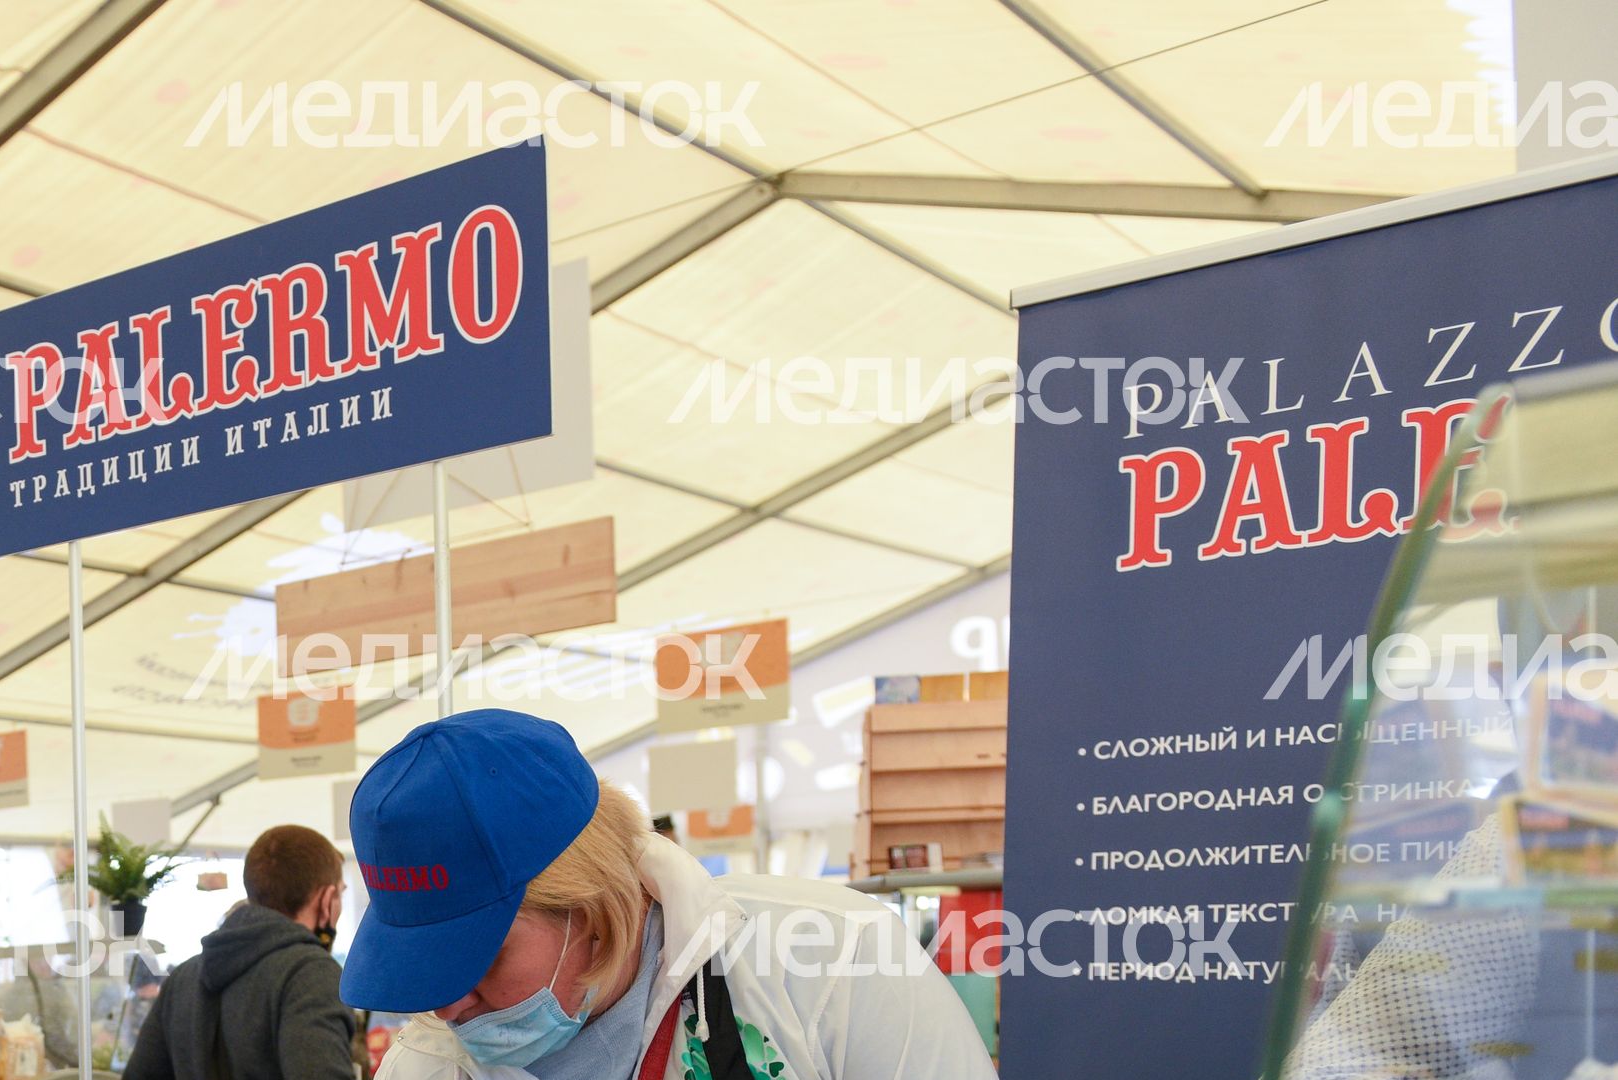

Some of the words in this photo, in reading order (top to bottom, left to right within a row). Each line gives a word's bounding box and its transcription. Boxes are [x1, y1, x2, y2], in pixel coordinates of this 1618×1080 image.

[9, 204, 523, 463] PALERMO
[10, 435, 201, 508] ТРАДИЦИИ
[225, 387, 393, 457] ИТАЛИИ
[1093, 726, 1237, 760] СЛОЖНЫЙ
[1246, 728, 1266, 747] И
[1092, 785, 1293, 815] БЛАГОРОДНАЯ
[1089, 903, 1198, 926] ЛОМКАЯ
[1088, 961, 1195, 984] ПЕРИОД
